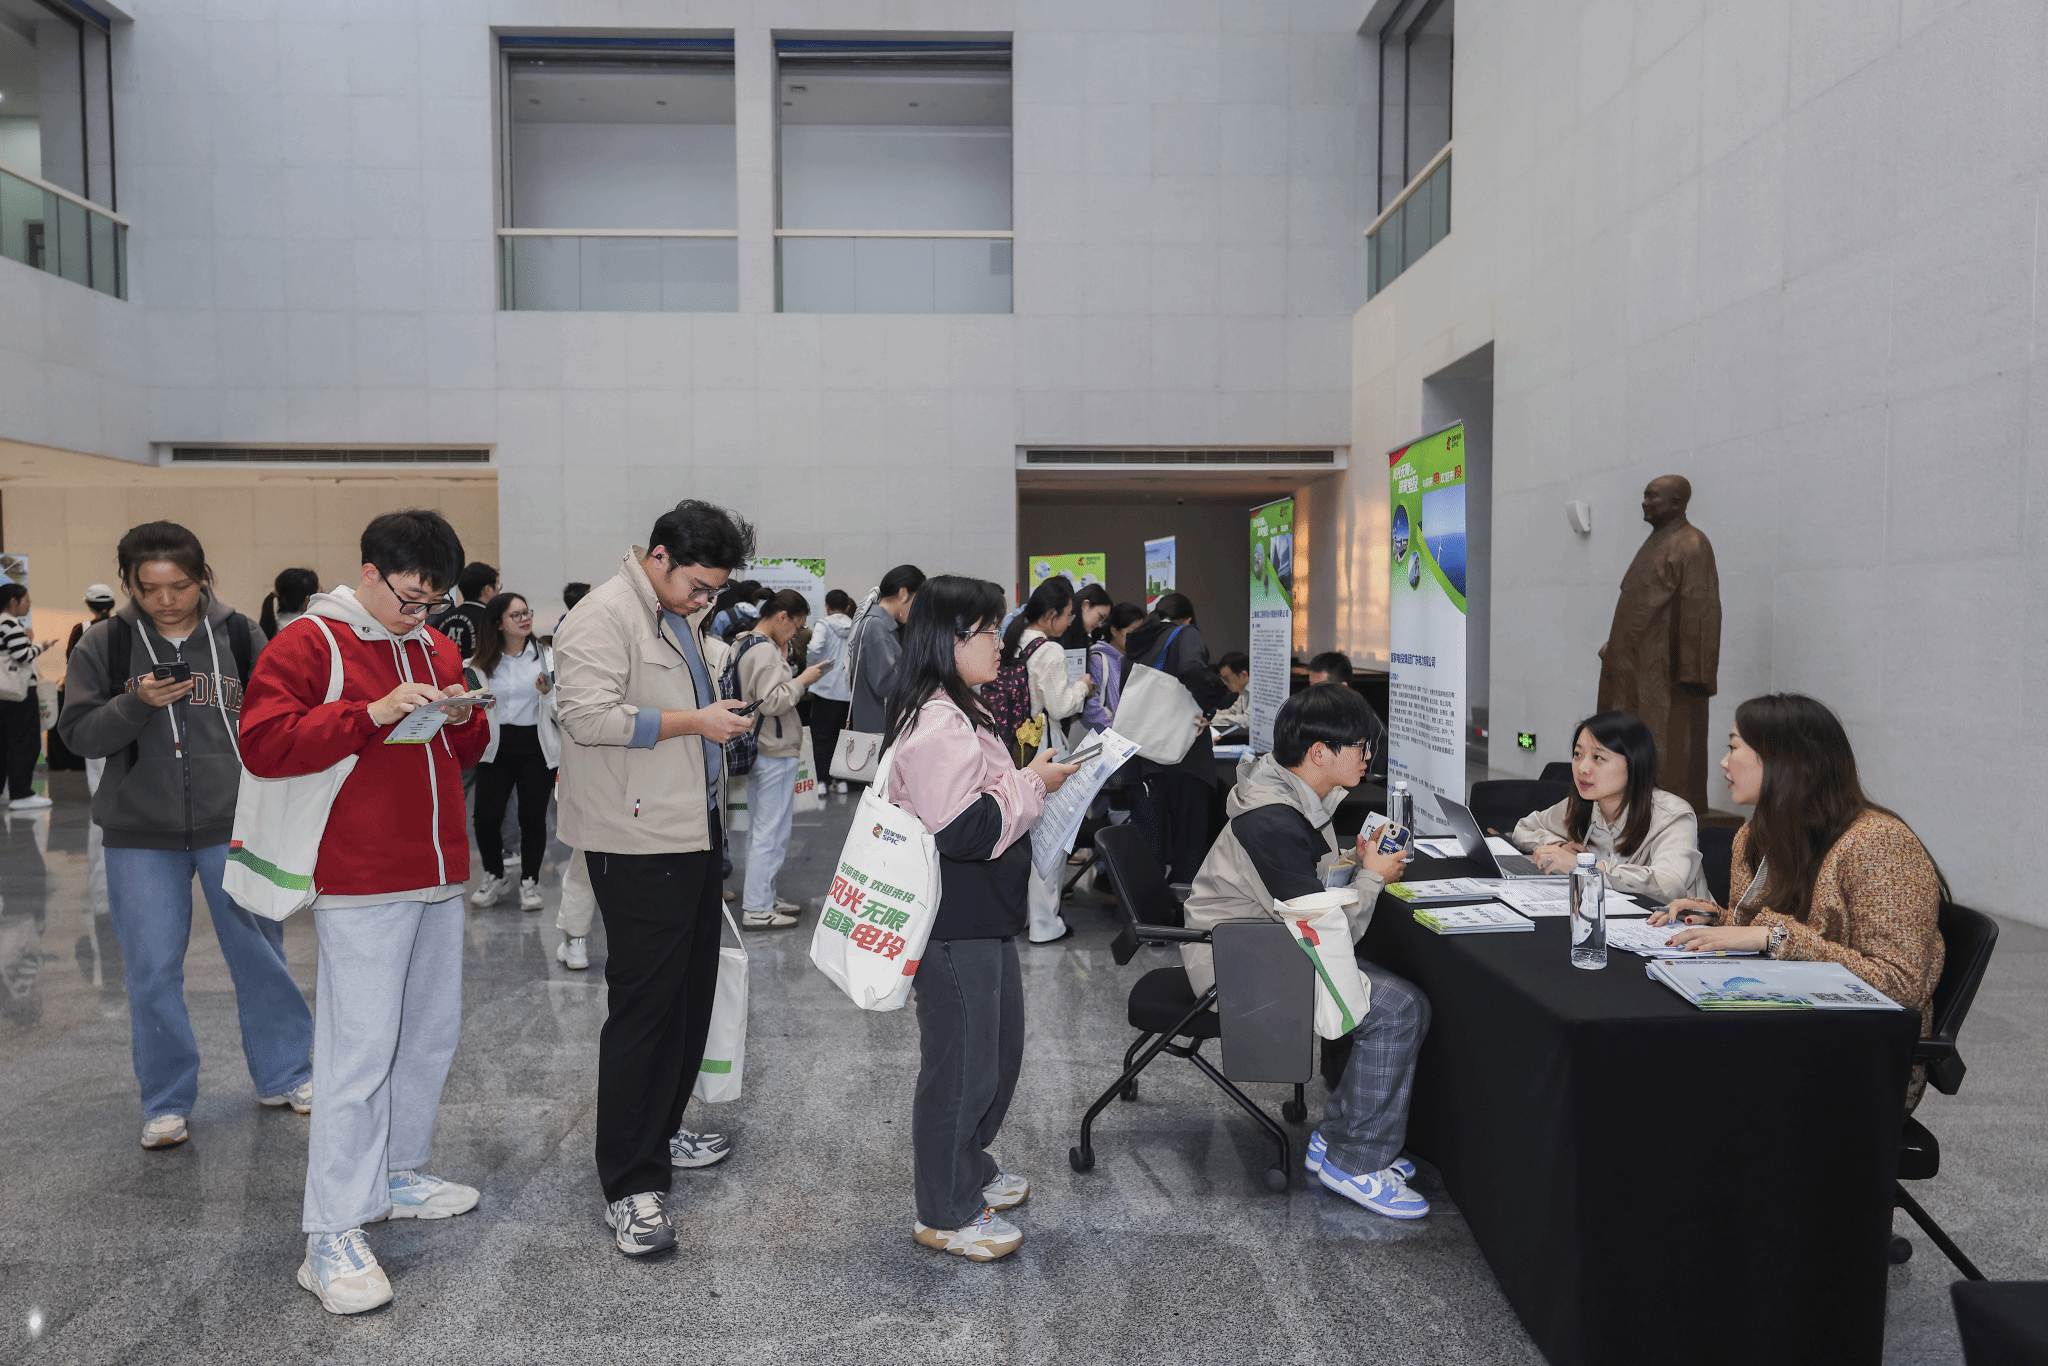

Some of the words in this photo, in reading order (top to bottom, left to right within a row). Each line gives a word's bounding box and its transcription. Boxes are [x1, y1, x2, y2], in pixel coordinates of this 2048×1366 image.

[882, 834, 899, 845] SPIC
[828, 875, 911, 932] 风光无限
[840, 862, 869, 886] 与你来电
[869, 880, 916, 903] 欢迎来投
[822, 907, 906, 961] 国家电投
